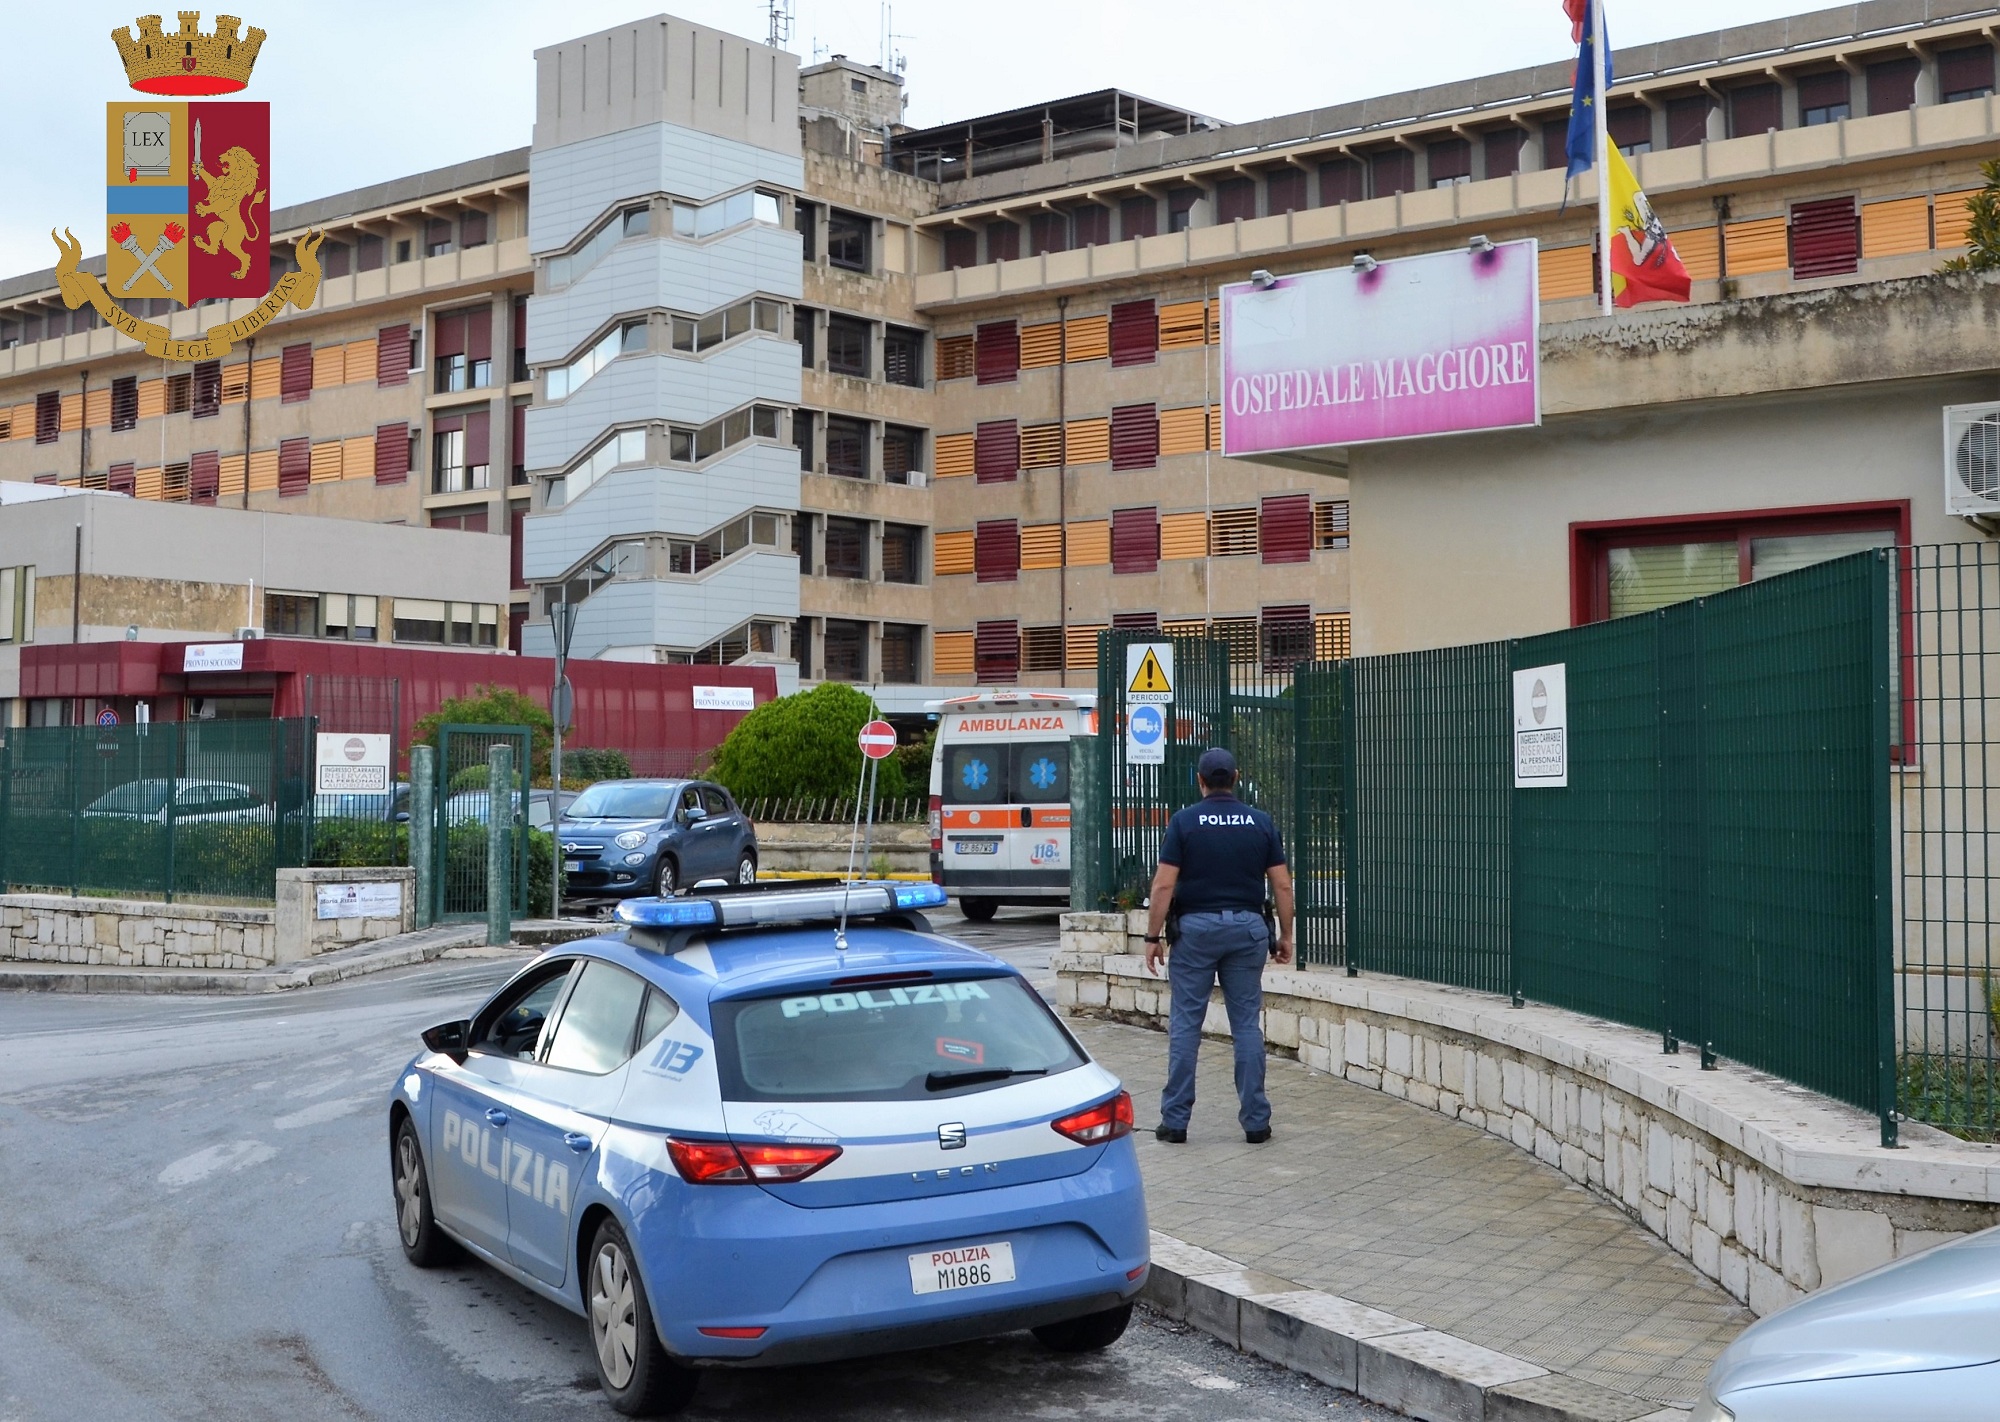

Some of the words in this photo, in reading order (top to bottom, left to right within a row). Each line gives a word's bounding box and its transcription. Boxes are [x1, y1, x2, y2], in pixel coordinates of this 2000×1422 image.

[1230, 362, 1365, 417] OSPEDALE
[1371, 340, 1530, 400] MAGGIORE
[185, 659, 209, 667] PRONTO
[209, 658, 241, 667] SOCCORSO
[695, 698, 720, 707] PRONTO
[720, 699, 753, 707] SOCCORSO
[958, 716, 1064, 732] AMBULANZA
[1520, 734, 1539, 743] INGRESSO
[1540, 732, 1561, 743] CARRABILE
[1520, 743, 1562, 757] RISERVATO
[1520, 756, 1528, 765] AL
[1528, 755, 1562, 765] PERSONALE
[1522, 764, 1560, 773] AUTORIZZATO
[1198, 814, 1255, 825] POLIZIA
[1034, 843, 1054, 859] 118
[780, 983, 991, 1018] POLIZIA
[649, 1038, 704, 1075] 113
[785, 1136, 812, 1144] SQUADRA
[812, 1137, 838, 1145] VOLANTE
[442, 1109, 569, 1217] POLIZIA
[912, 1162, 998, 1183] LEON
[932, 1246, 991, 1267] POLIZIA
[937, 1263, 992, 1290] M1886
